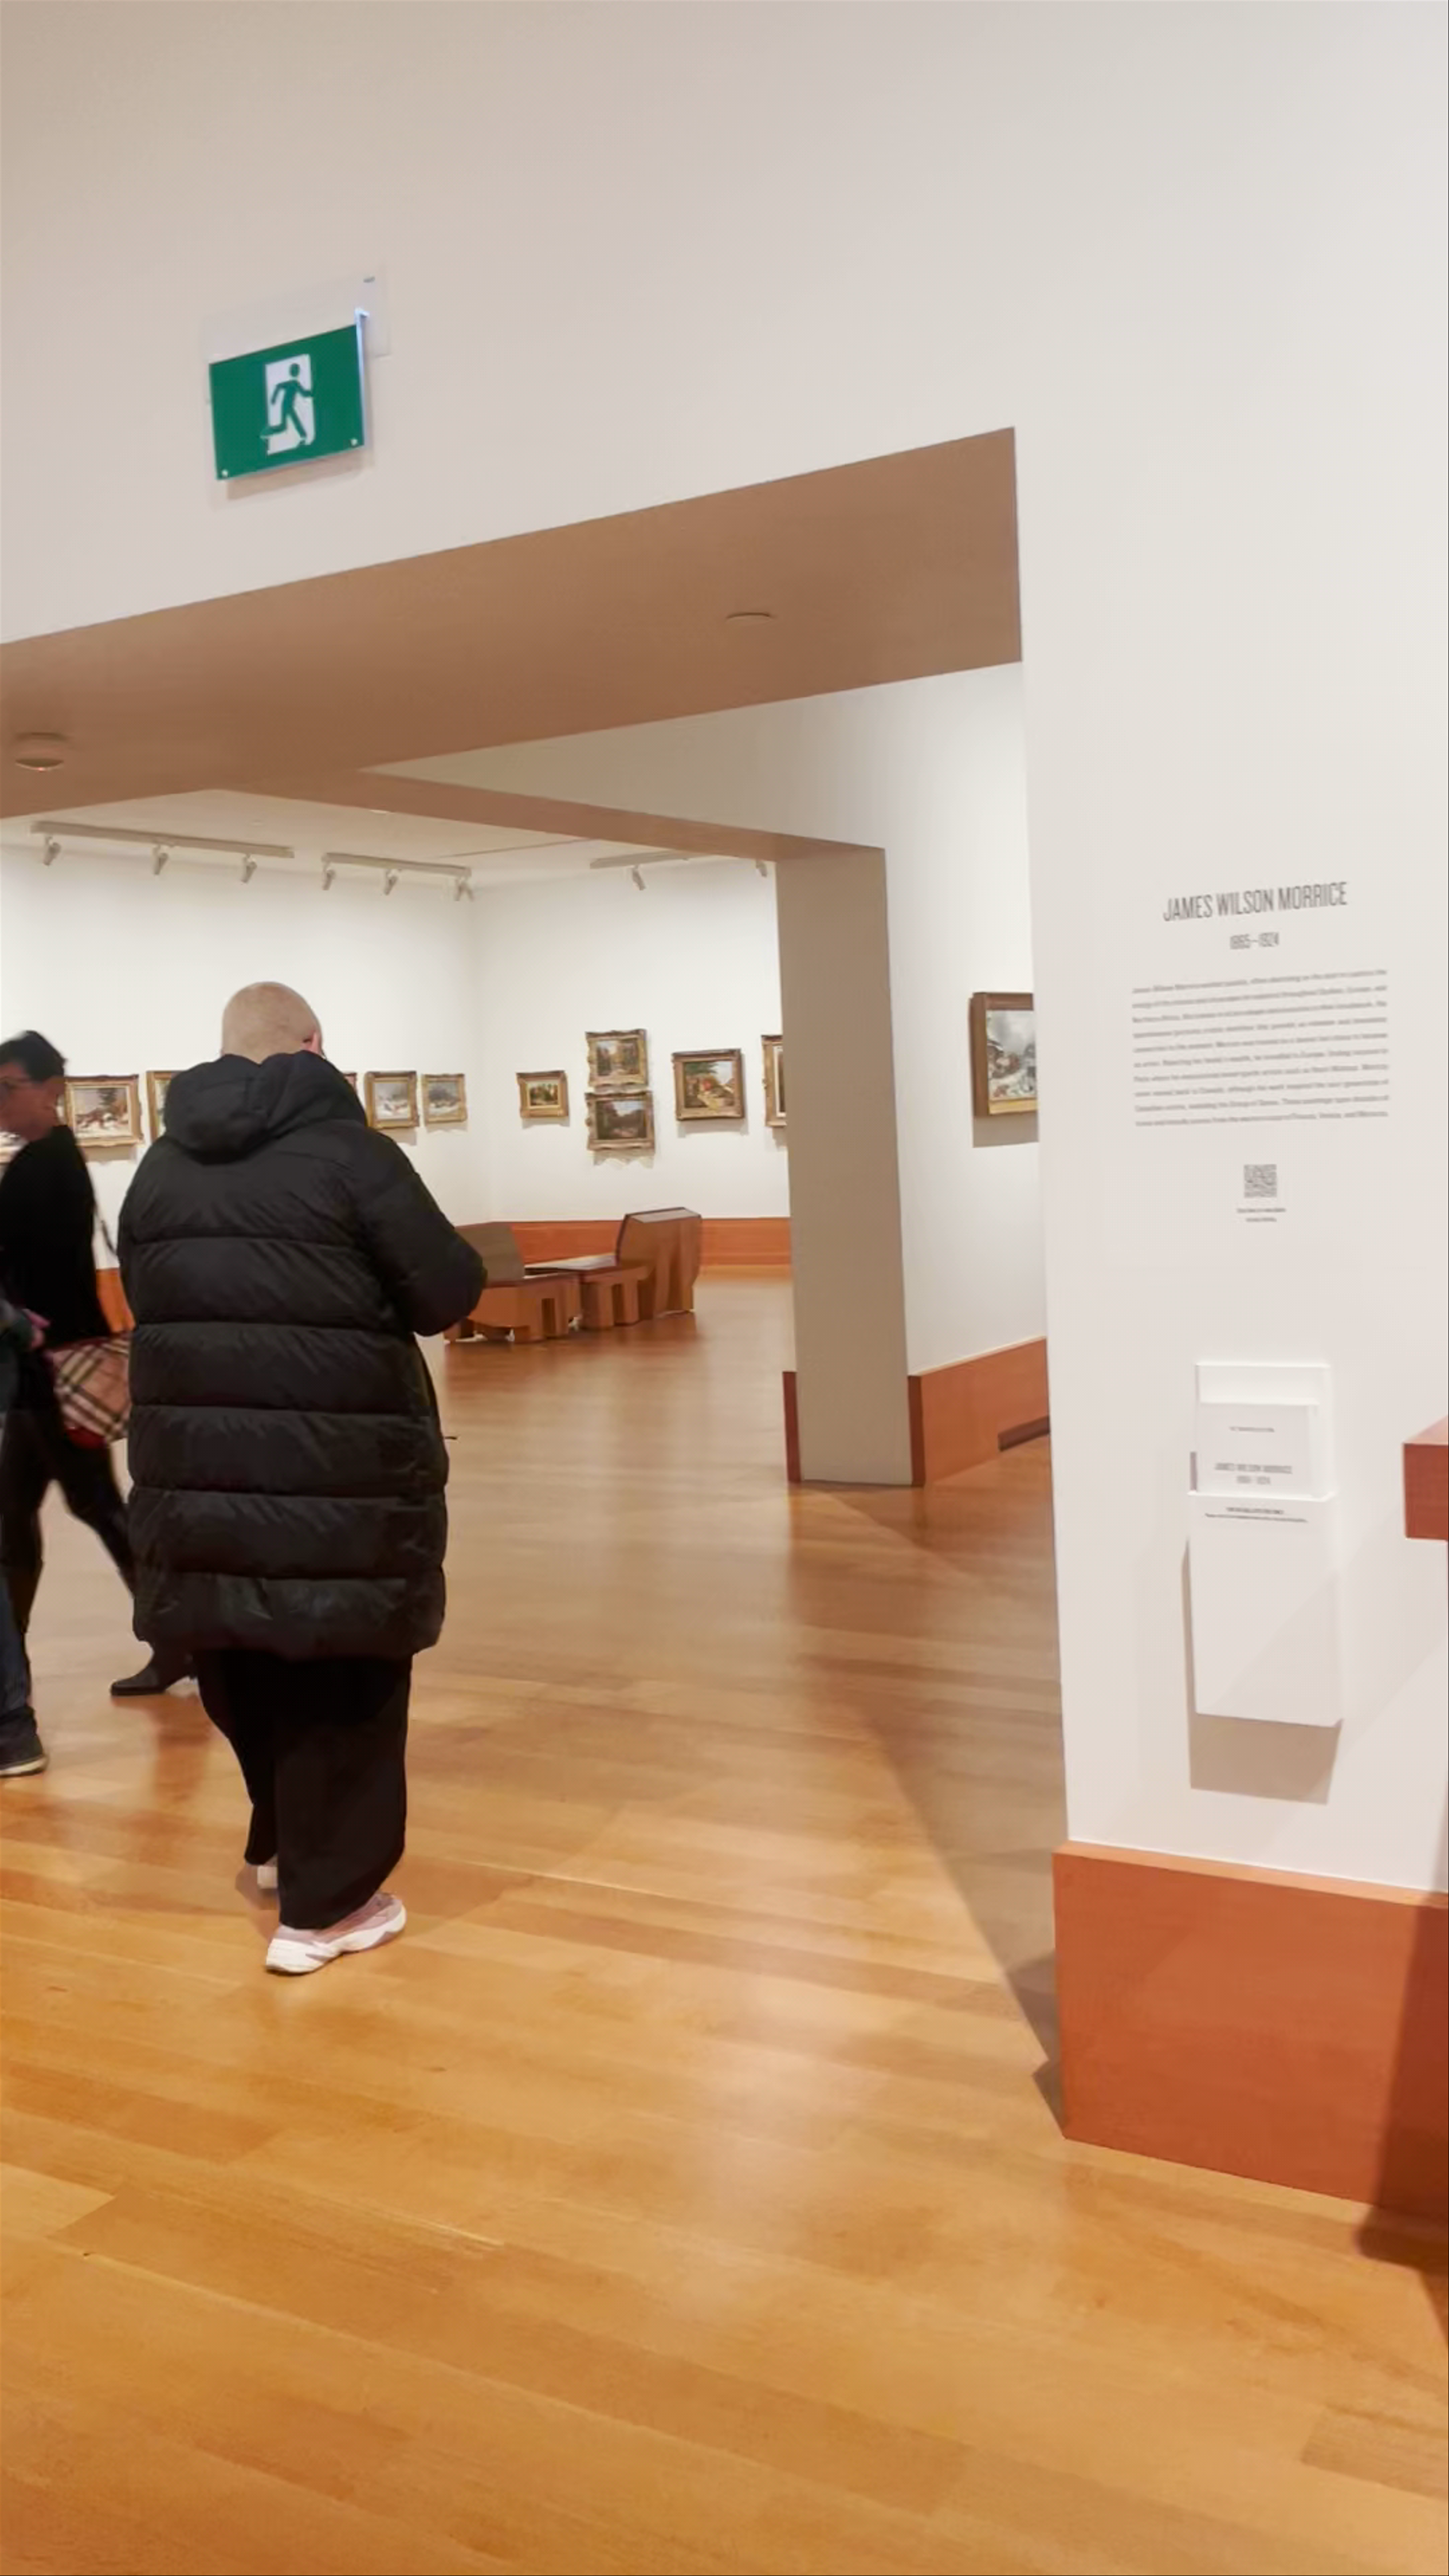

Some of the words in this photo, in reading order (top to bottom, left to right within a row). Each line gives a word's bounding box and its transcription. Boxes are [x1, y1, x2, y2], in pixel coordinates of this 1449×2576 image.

[1163, 894, 1213, 921] JAMES
[1216, 889, 1274, 915] WILSON
[1278, 882, 1347, 910] MORRICE
